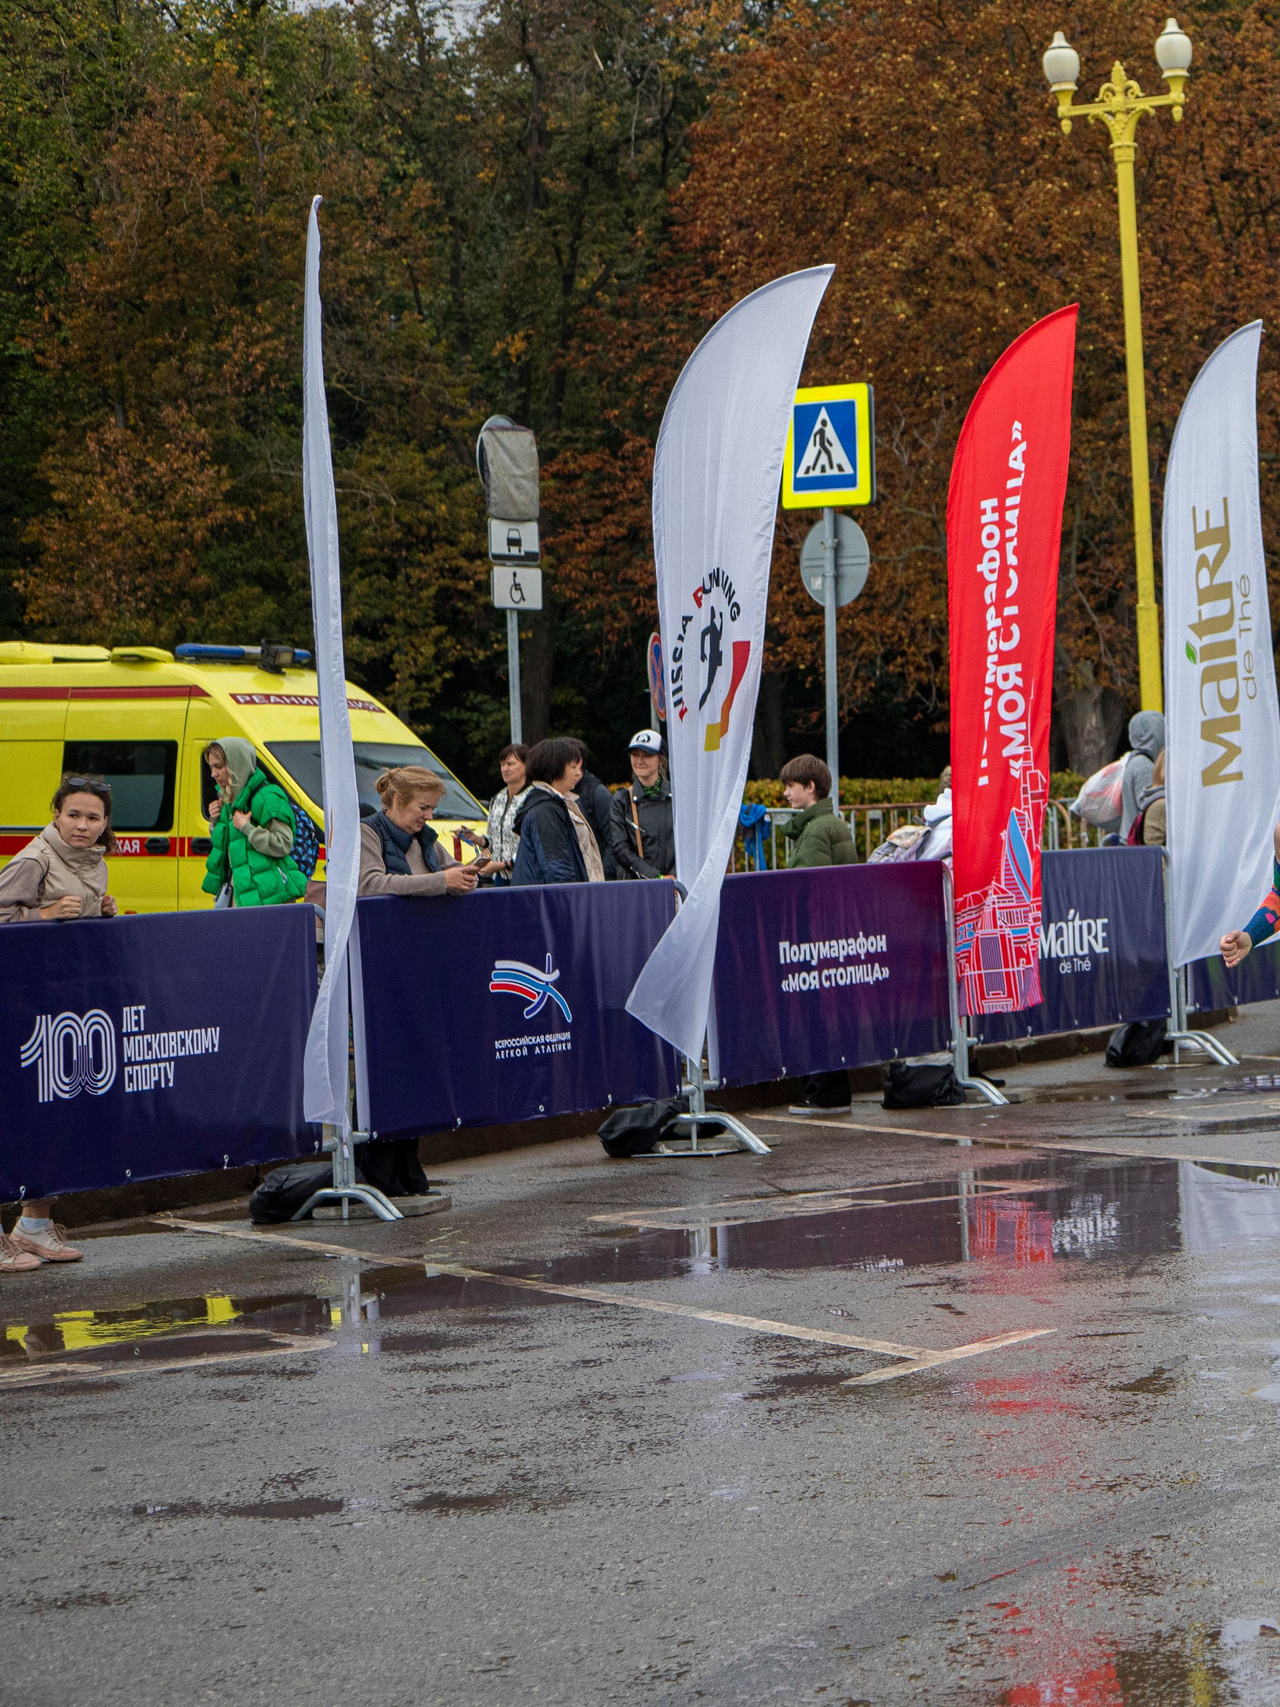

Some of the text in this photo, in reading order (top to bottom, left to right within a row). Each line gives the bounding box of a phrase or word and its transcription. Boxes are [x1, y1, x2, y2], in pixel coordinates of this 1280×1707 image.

[1235, 573, 1258, 700] de Thé
[236, 694, 380, 711] РЕАНИЦИЯ
[996, 663, 1027, 779] «МОЯ
[779, 931, 887, 966] Полумарафон
[781, 962, 890, 993] «МОЯ СТОЛИЦА»
[1059, 957, 1091, 974] de Thé
[122, 1005, 146, 1033] ЛЕТ
[20, 1008, 117, 1103] 100
[122, 1026, 220, 1063] МОСКОВСКОМУ
[494, 1035, 545, 1050] ВСЕРОССИЙСКАЯ
[495, 1042, 572, 1060] ЛЕГКОЙ АТЛЕТИКИ
[124, 1061, 175, 1093] СПОРТУ
